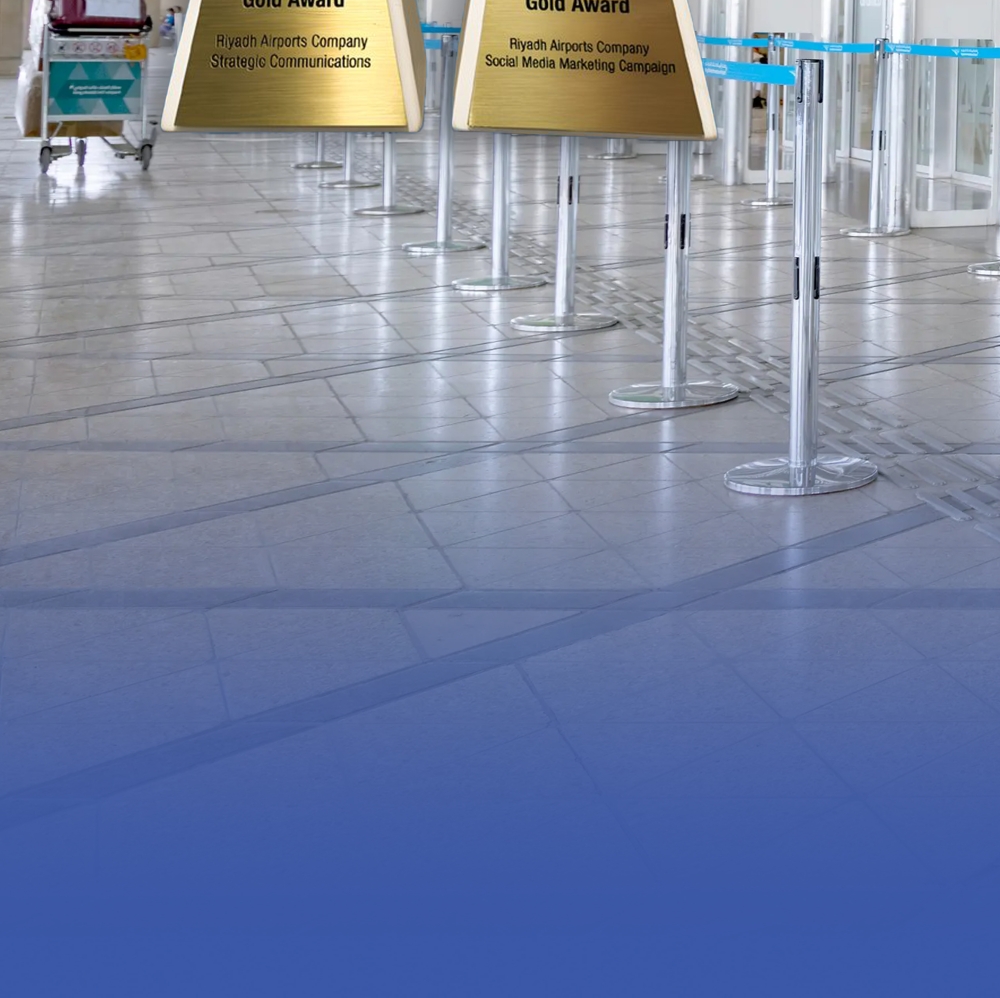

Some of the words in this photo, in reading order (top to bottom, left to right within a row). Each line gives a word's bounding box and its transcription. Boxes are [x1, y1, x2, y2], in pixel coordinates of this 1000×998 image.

[216, 34, 257, 50] Riyadh
[260, 34, 308, 51] Airports
[311, 34, 368, 50] Company
[509, 38, 547, 52] Riyadh
[550, 40, 593, 54] Airports
[596, 41, 650, 57] Company
[210, 53, 266, 70] Strategic
[269, 53, 372, 69] Communications
[485, 54, 519, 68] Social
[522, 56, 556, 70] Media
[559, 58, 615, 73] Marketing
[618, 60, 676, 75] Campaign
